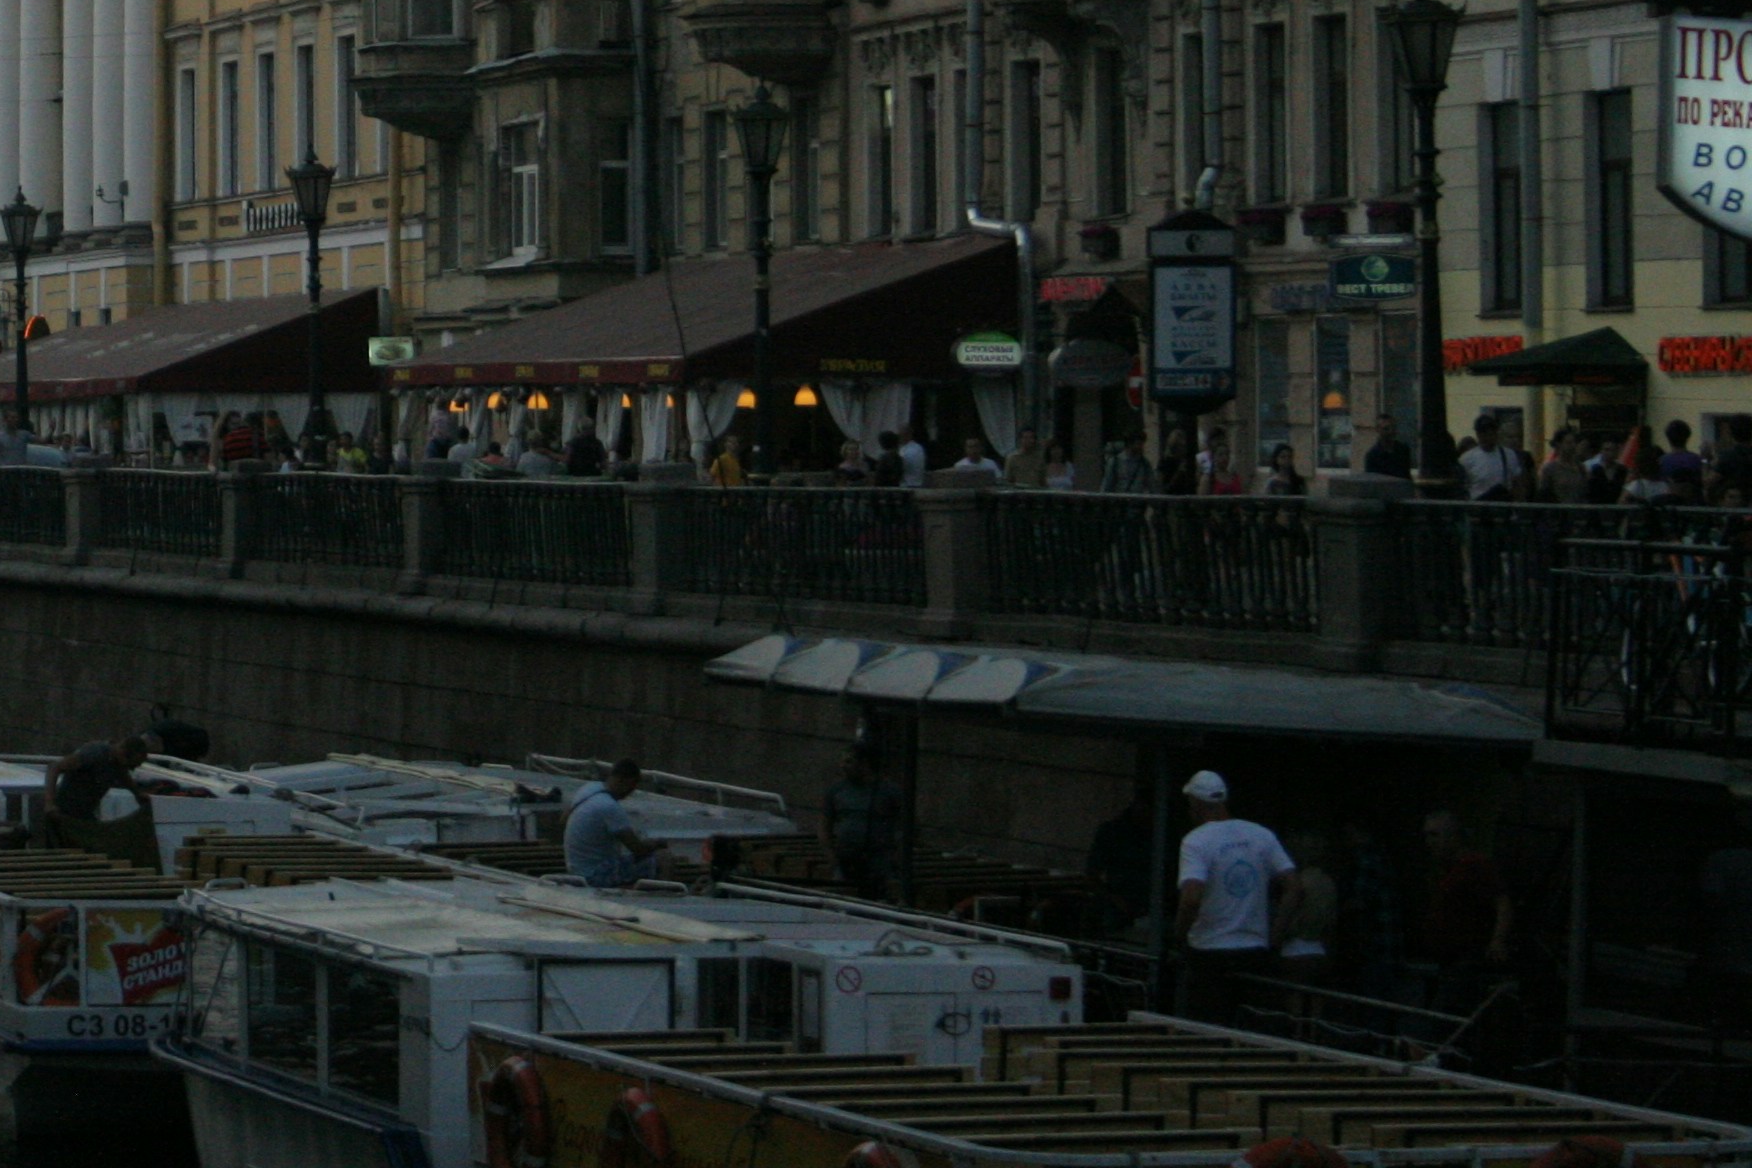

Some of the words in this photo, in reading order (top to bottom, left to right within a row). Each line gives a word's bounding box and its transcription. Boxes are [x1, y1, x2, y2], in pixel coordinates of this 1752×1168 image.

[1676, 96, 1701, 125] ПО
[1336, 283, 1366, 295] ВЕСТ
[964, 345, 1014, 354] СЛУХОВЫЕ
[964, 354, 1014, 363] АППАРАТЫ
